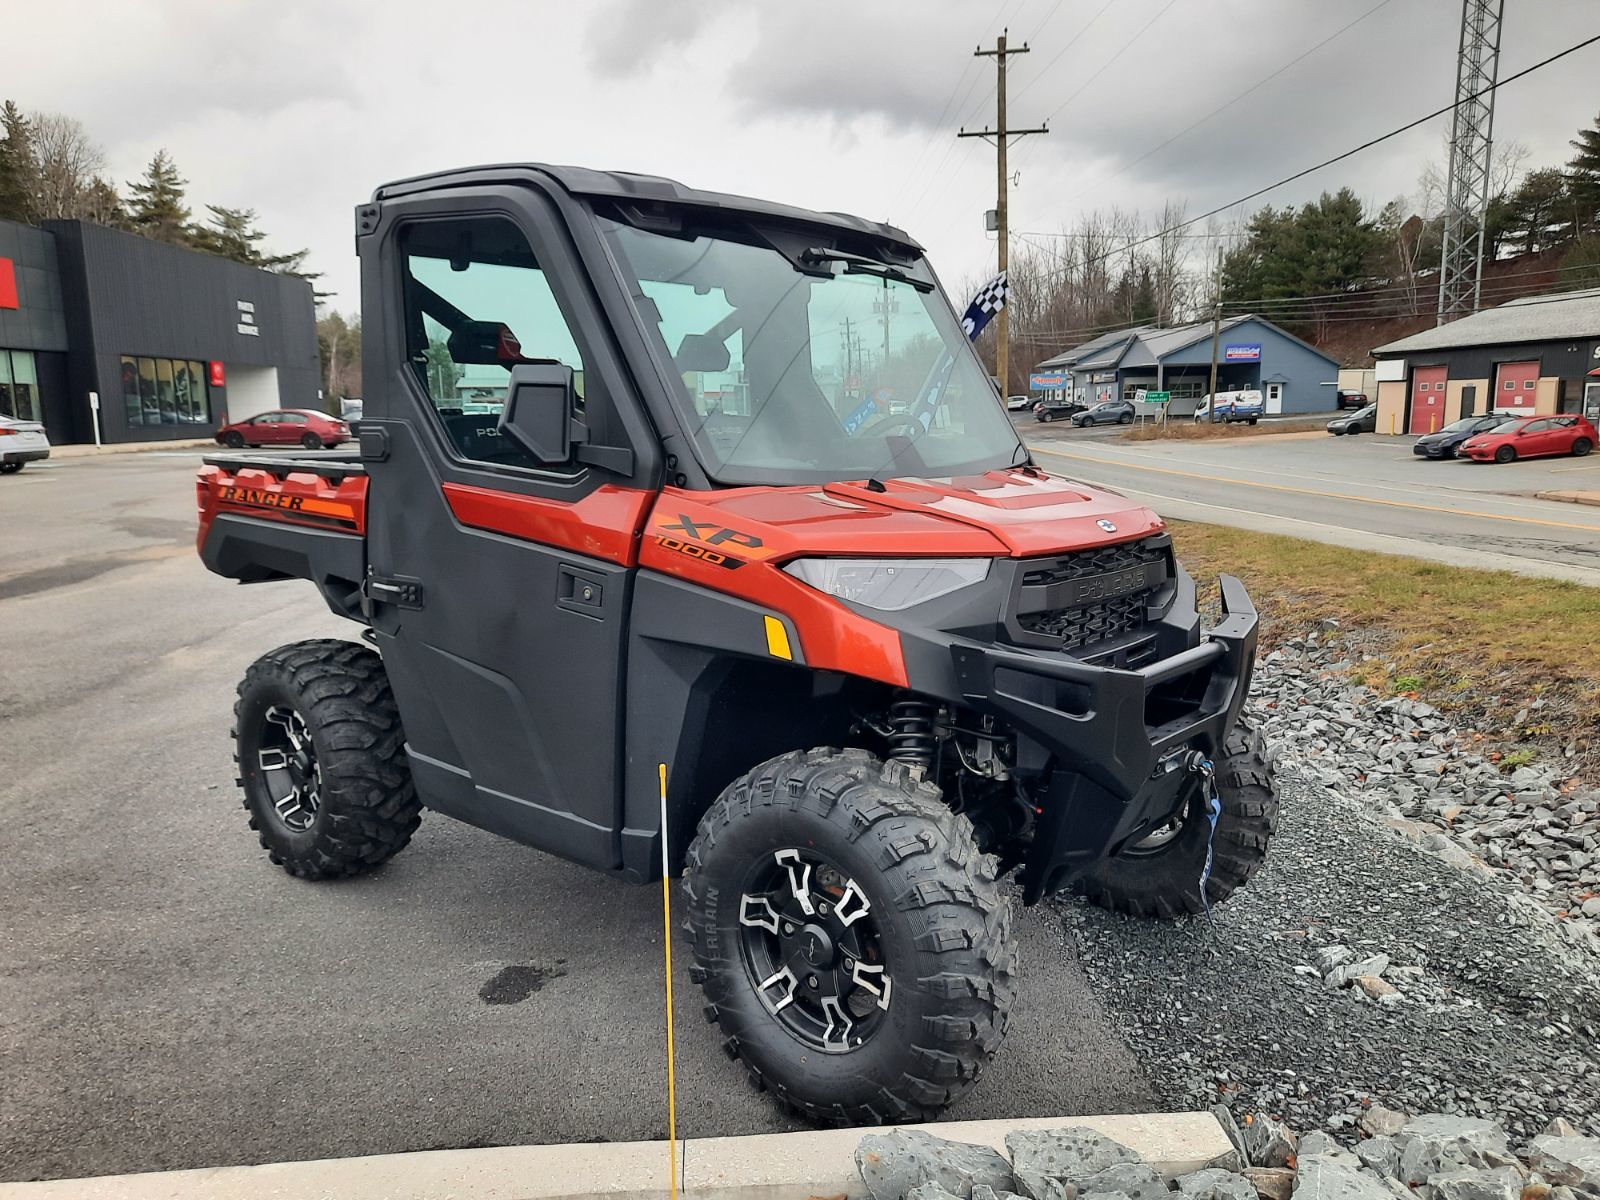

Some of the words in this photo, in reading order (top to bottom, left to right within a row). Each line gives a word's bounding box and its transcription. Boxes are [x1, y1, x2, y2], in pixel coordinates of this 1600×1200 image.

[1136, 393, 1145, 401] 50
[224, 486, 304, 510] RANGER
[658, 513, 763, 549] XP
[655, 535, 726, 565] 1000
[1076, 570, 1145, 602] POLARIS
